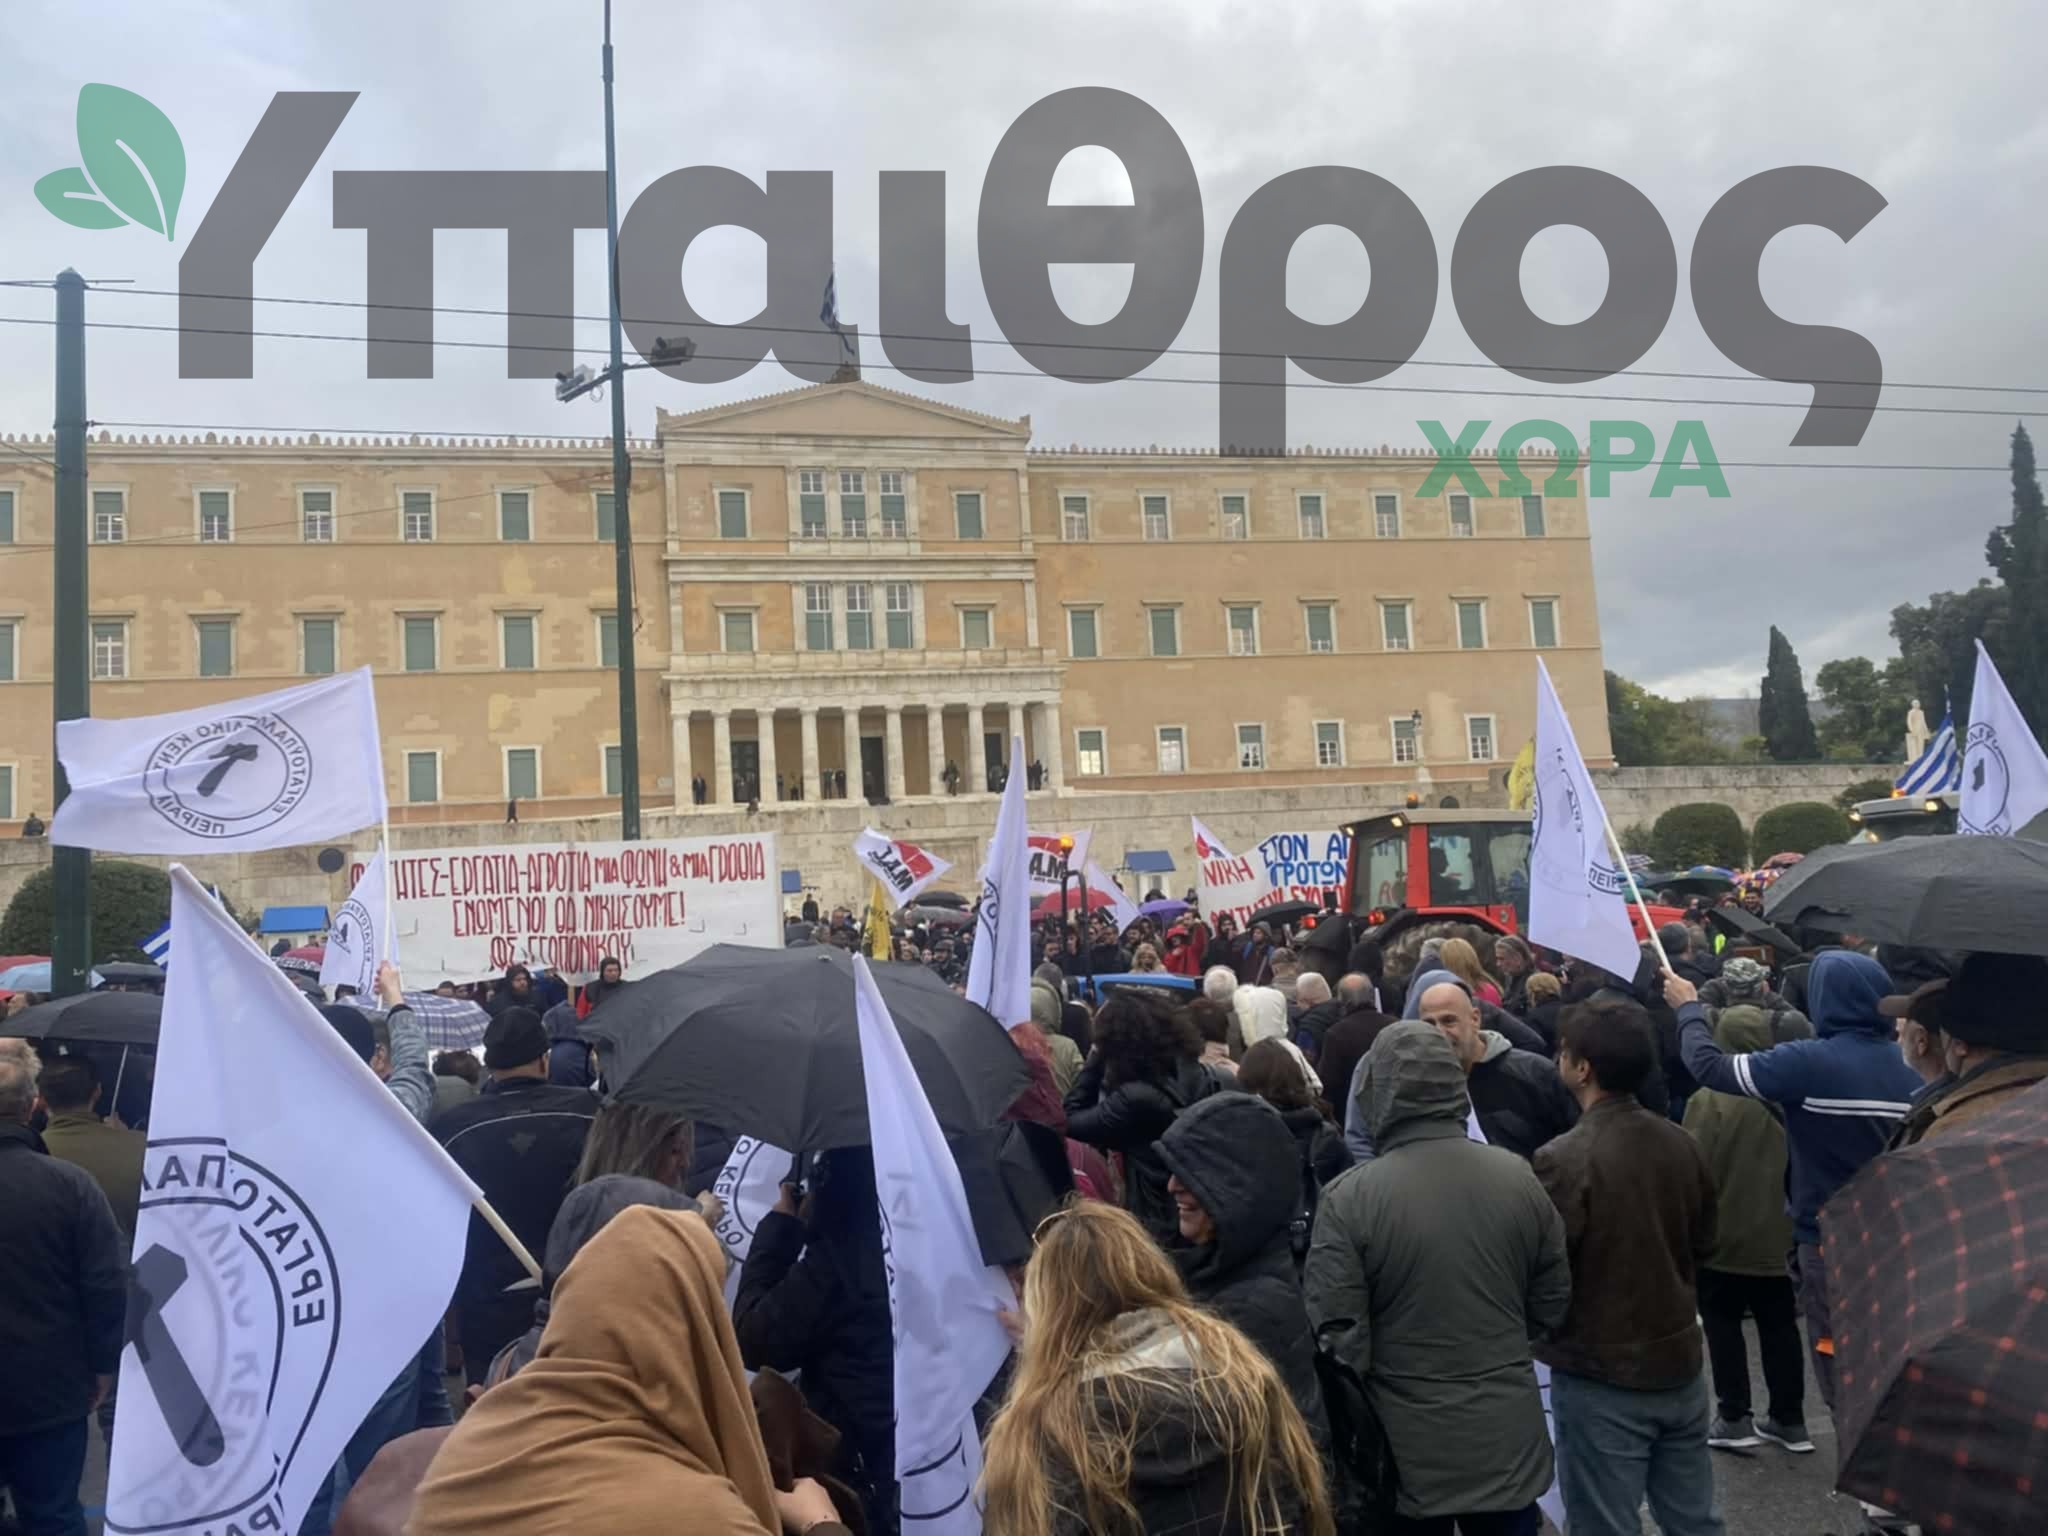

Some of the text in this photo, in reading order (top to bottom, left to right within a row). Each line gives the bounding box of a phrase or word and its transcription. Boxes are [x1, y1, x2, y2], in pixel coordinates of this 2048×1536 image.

[594, 856, 618, 884] ΜΙΑ
[620, 847, 668, 888] ΦΩΝΗ
[670, 854, 683, 878] &
[683, 851, 709, 879] ΜΙΑ
[1203, 856, 1254, 887] ΝΙΚΗ
[1258, 833, 1308, 868] ΣΤΟΝ
[453, 890, 686, 936] ΕΝΩΜΕΝΟΙ ΘΑ ΝΙΚΗΣΟΥΜΕ!
